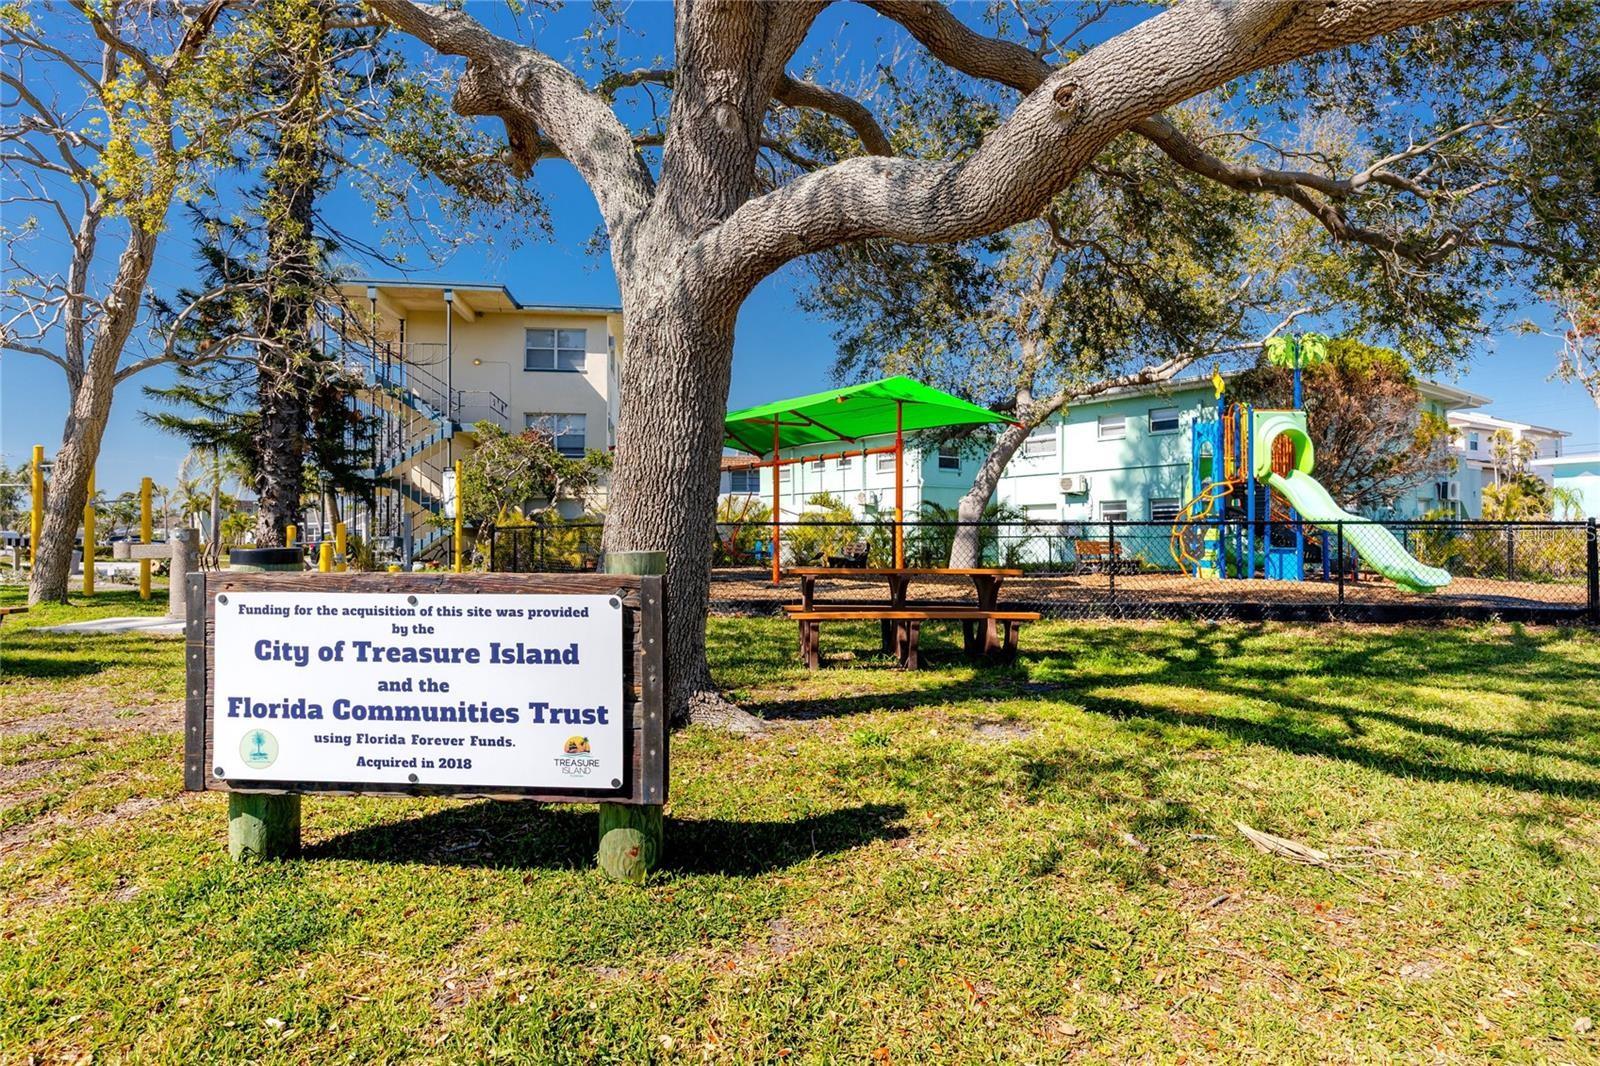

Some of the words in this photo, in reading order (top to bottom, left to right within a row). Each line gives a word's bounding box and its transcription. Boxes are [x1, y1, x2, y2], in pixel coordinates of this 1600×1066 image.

[238, 603, 291, 619] Funding
[294, 604, 313, 616] for
[316, 604, 338, 616] the
[342, 604, 416, 619] acquisition
[419, 604, 434, 617] of
[436, 605, 463, 617] this
[466, 606, 492, 618] site
[495, 608, 524, 618] was
[527, 606, 590, 620] provided
[391, 623, 409, 637] by
[412, 623, 435, 635] the
[254, 639, 309, 667] City
[318, 640, 346, 663] of
[352, 640, 481, 664] Treasure
[489, 642, 580, 665] Island
[377, 677, 413, 693] and
[418, 677, 450, 693] the
[227, 696, 324, 720] Florida
[332, 698, 520, 724] Communities
[528, 702, 609, 725] Trust
[313, 732, 352, 748] using
[356, 732, 406, 746] Florida
[411, 734, 466, 746] Forever
[470, 735, 516, 748] Funds.
[356, 756, 418, 770] Acquired
[421, 757, 435, 769] in
[438, 757, 473, 770] 2018
[553, 758, 600, 768] TREASURE
[561, 766, 592, 775] ISLAND
